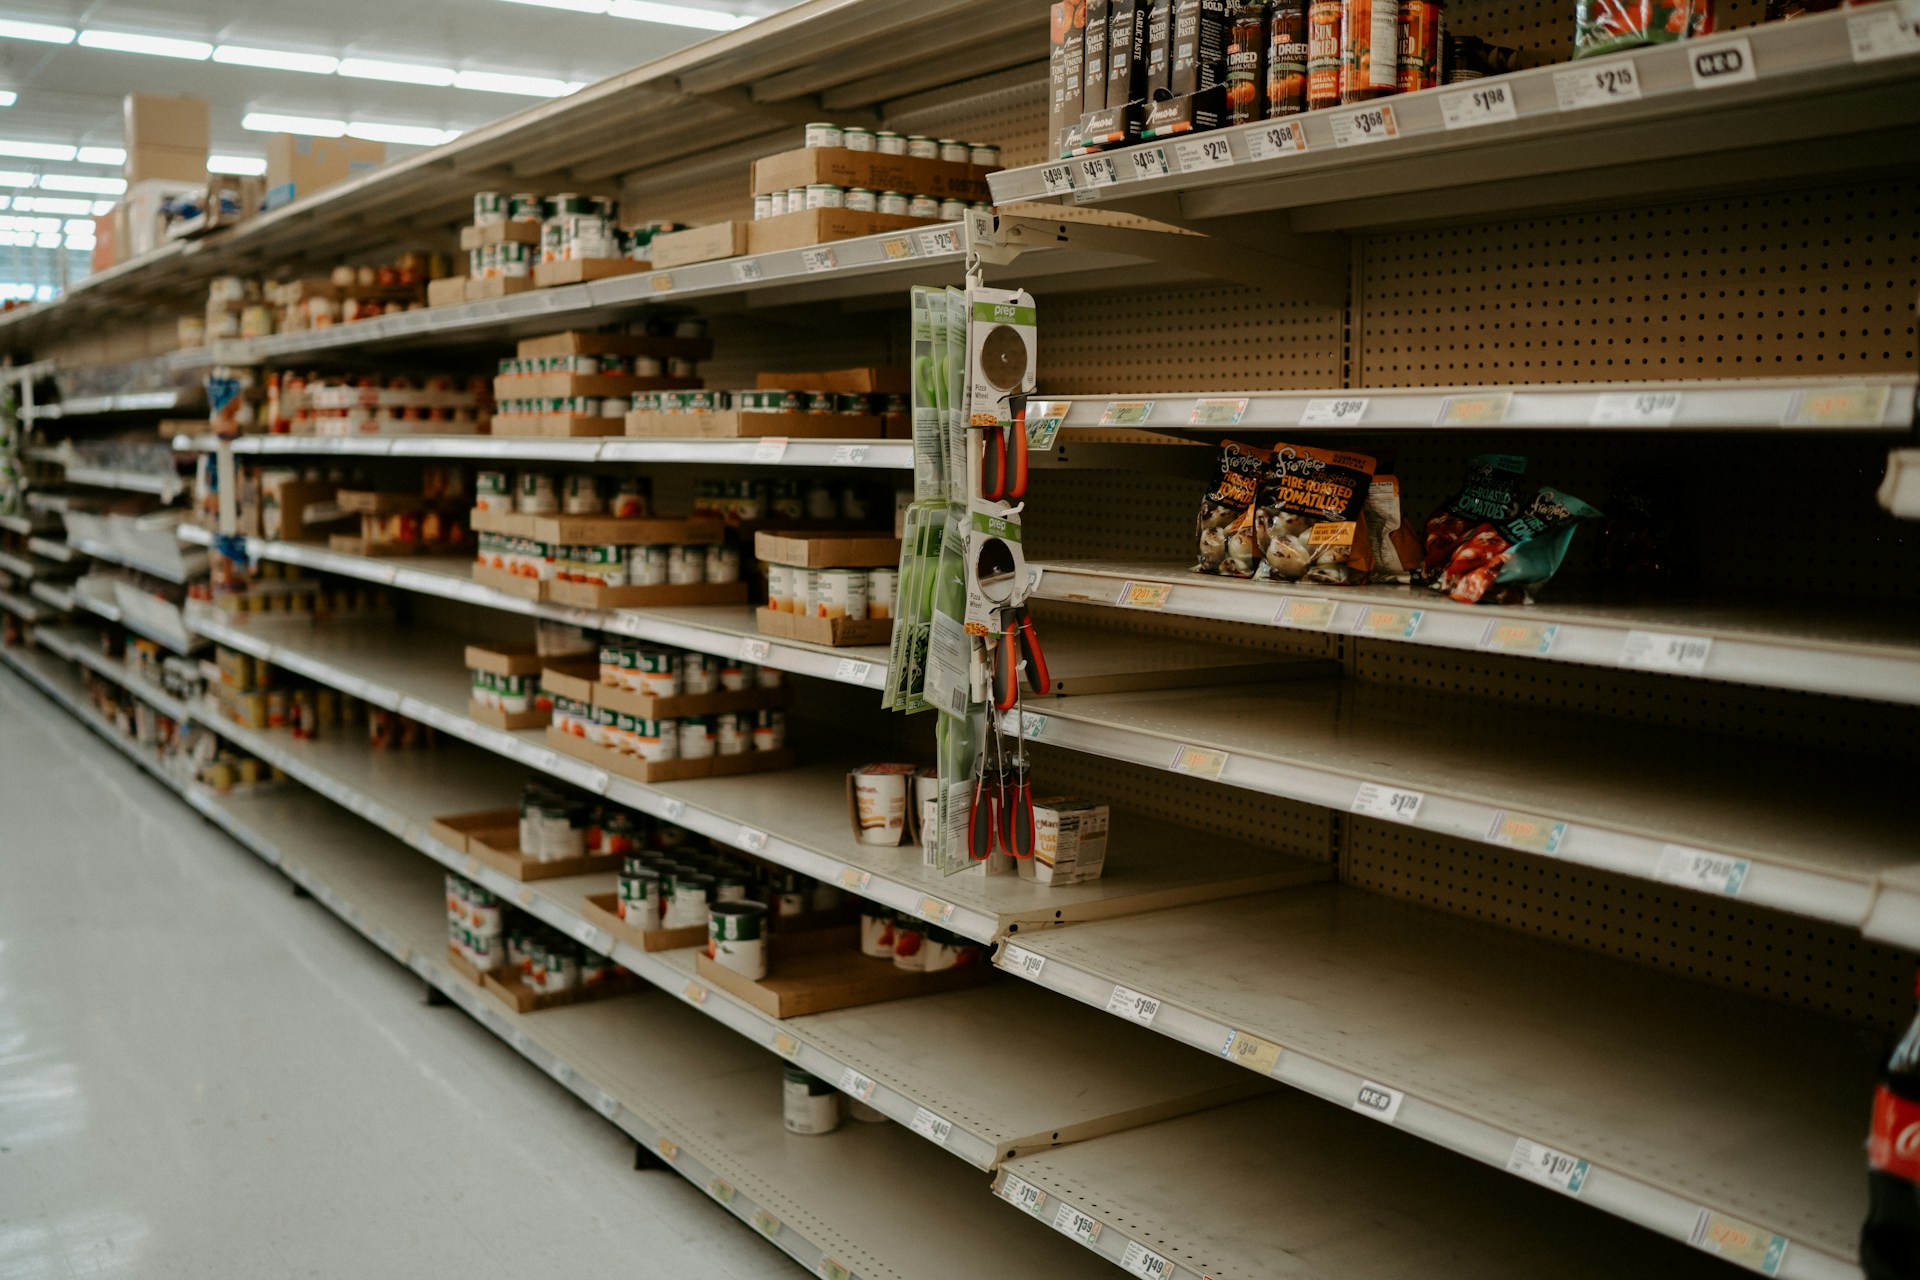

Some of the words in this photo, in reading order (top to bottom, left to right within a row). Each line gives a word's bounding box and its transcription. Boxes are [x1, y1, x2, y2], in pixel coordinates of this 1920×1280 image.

[1202, 2, 1223, 12] BOLD
[1086, 16, 1106, 31] Amore
[1112, 10, 1133, 24] Amore
[1136, 10, 1145, 35] GARLIC
[1178, 16, 1196, 28] PESTO
[1112, 27, 1131, 40] GARLIC
[1150, 22, 1166, 34] PESTO
[1177, 25, 1195, 38] PASTE
[1314, 24, 1332, 40] SUN
[1086, 33, 1105, 46] GARLIC
[1113, 37, 1129, 48] PASTE
[1149, 32, 1166, 44] PASTE
[1087, 42, 1103, 55] PASTE
[1133, 35, 1143, 60] PASTE
[1278, 43, 1307, 55] DRIED
[1310, 37, 1337, 58] DRIED
[1064, 56, 1083, 68] TOMATO
[1230, 52, 1257, 66] DRIED
[1066, 65, 1080, 75] PASTE
[1053, 76, 1064, 85] PAS
[1146, 100, 1179, 125] Amore
[1085, 115, 1114, 134] Amore
[993, 305, 1016, 318] prep
[974, 383, 987, 392] Pizza
[974, 391, 989, 400] Wheel
[1311, 470, 1357, 488] CRUSHED
[1280, 475, 1353, 499] FIRE-ROASTED
[1277, 486, 1349, 512] TOMATILLOS
[1459, 494, 1505, 520] OMATOES
[988, 517, 1006, 532] prep
[970, 592, 981, 601] Pizza
[969, 599, 982, 609] Wheel
